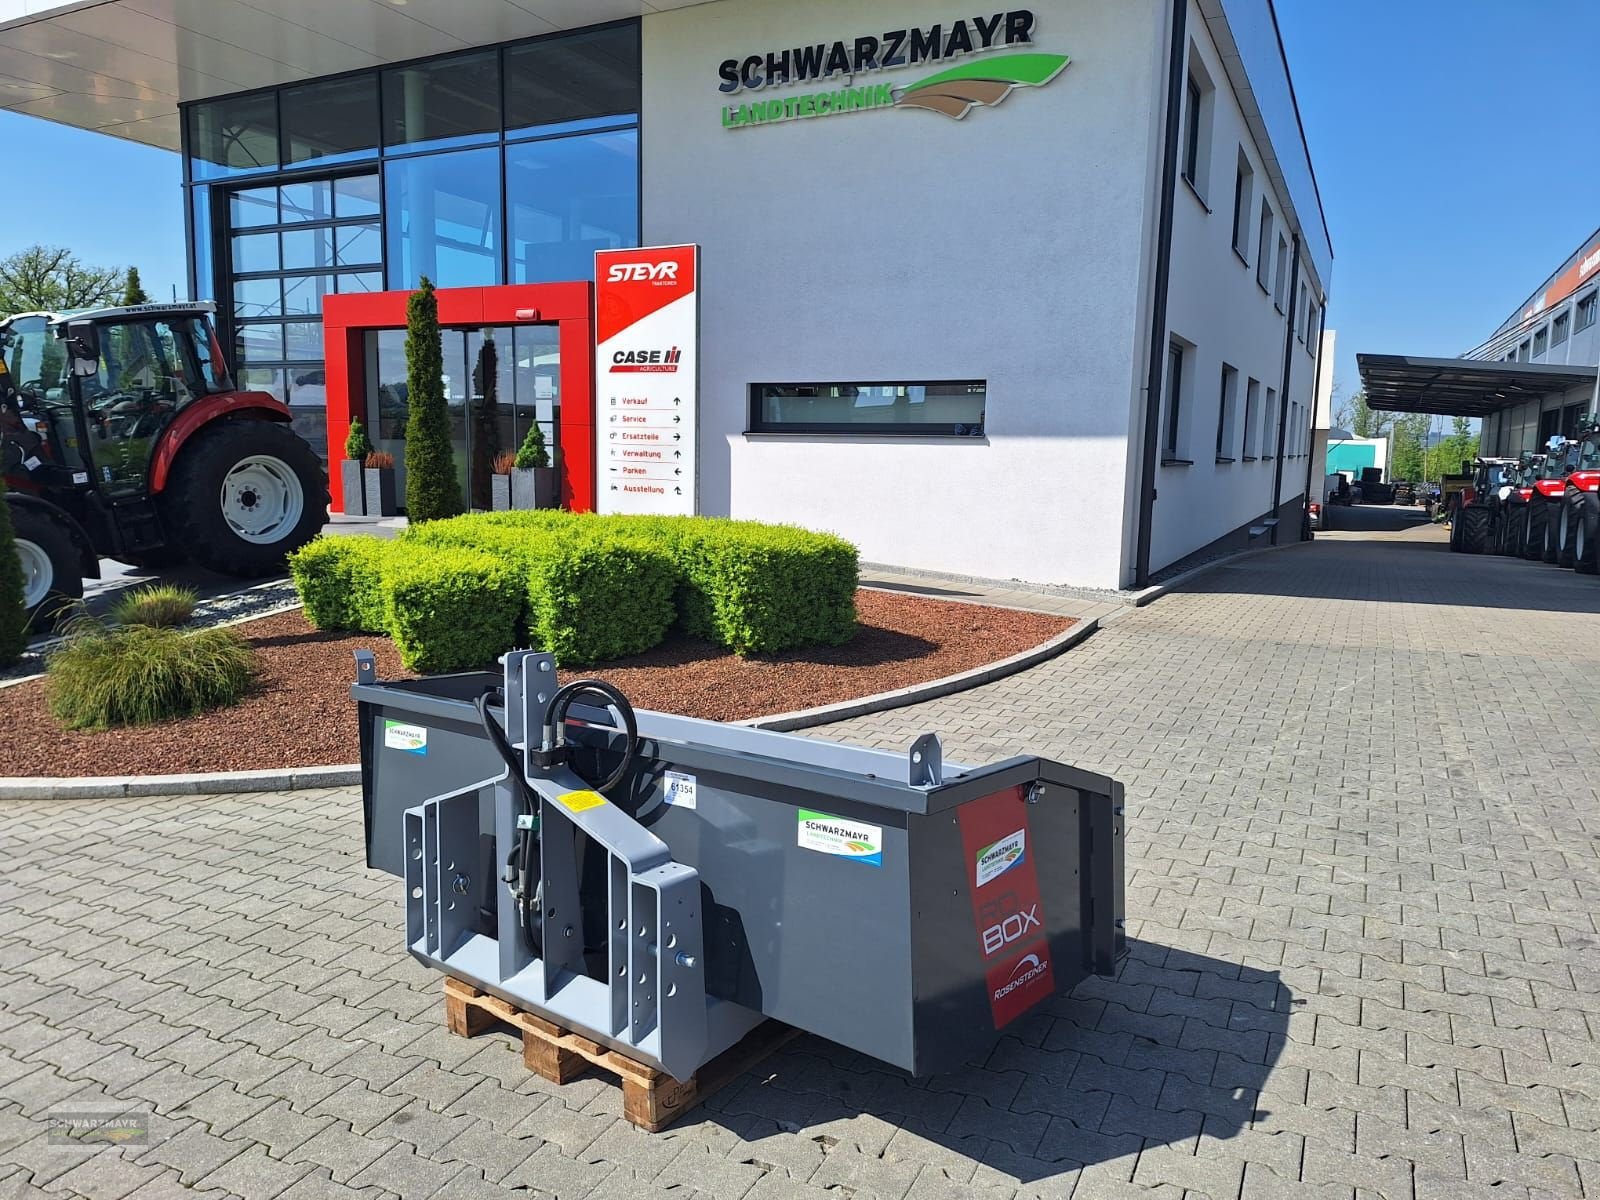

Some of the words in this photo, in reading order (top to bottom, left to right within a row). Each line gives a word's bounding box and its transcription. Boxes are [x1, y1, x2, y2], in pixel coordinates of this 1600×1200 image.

[718, 9, 1036, 95] SCHWARZMAYR
[722, 82, 896, 128] LANDTECHNIK
[607, 261, 679, 282] STEYR
[613, 350, 662, 364] CASE
[622, 397, 648, 405] Verkauf
[622, 415, 647, 423] Service
[622, 450, 661, 459] Verwaltung
[622, 467, 647, 475] Parken
[623, 485, 665, 494] Ausstellung
[671, 782, 693, 795] 61354
[805, 820, 870, 841] SCHWARZMAYR
[981, 840, 1019, 866] SCHWARZMAYR
[982, 903, 1041, 955] BOX
[994, 960, 1048, 1001] ROSENSTEINER
